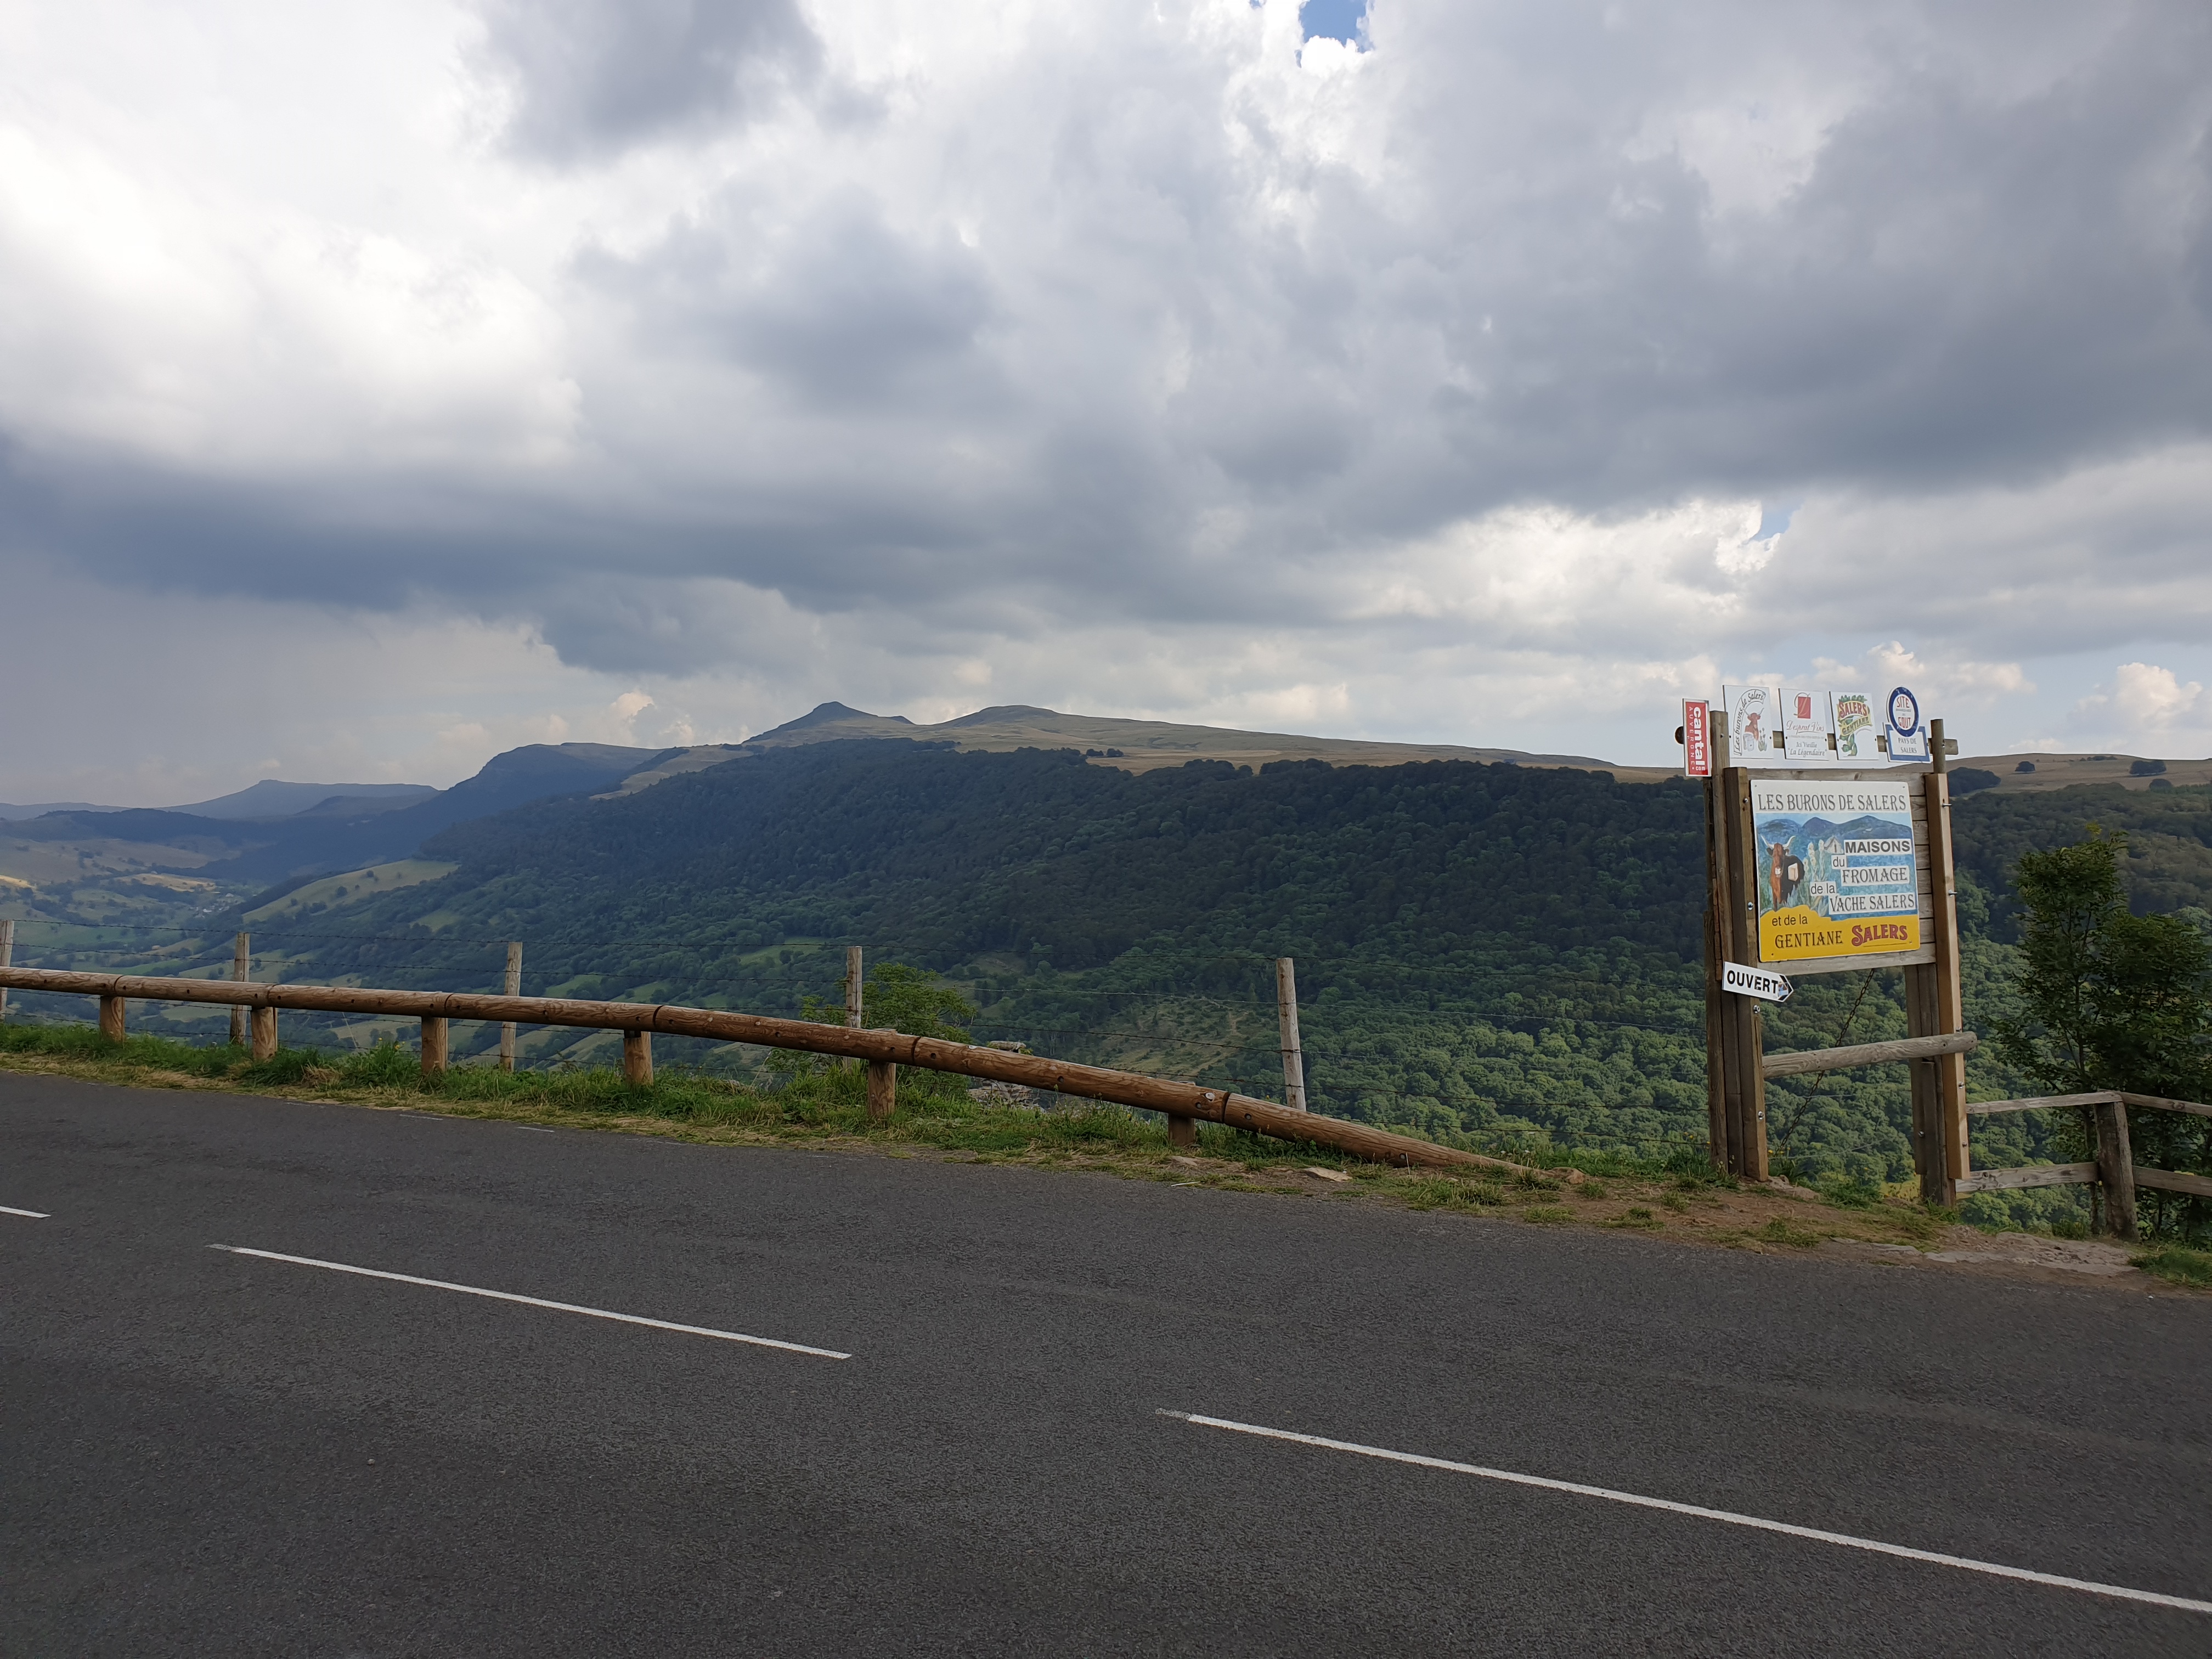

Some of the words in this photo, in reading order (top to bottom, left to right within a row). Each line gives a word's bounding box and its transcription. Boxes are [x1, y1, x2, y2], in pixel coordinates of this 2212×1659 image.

[1838, 701, 1867, 718] SALERS
[1897, 696, 1910, 708] SITE
[1734, 707, 1744, 735] burons
[1741, 697, 1747, 709] de
[1747, 690, 1764, 703] Salers
[1786, 720, 1810, 735] Desprat
[1811, 721, 1825, 732] Vins
[1842, 716, 1869, 735] GENTIANE
[1694, 707, 1706, 765] cantal
[1758, 794, 1784, 811] LES
[1787, 794, 1836, 811] BURONS
[1838, 794, 1855, 811] DE
[1858, 794, 1906, 811] SALERS
[1845, 840, 1910, 853] MAISONS
[1833, 856, 1845, 867] du
[1842, 867, 1908, 884] FROMAGE
[1811, 883, 1823, 894] de
[1826, 882, 1835, 894] la
[1830, 895, 1866, 912] VACHE
[1869, 894, 1915, 910] SALERS
[1771, 916, 1781, 927] et
[1784, 915, 1796, 926] de
[1799, 914, 1808, 925] la
[1775, 930, 1843, 949] GENTIANE
[1851, 924, 1908, 947] SALERS
[1726, 969, 1779, 994] OUVERT
